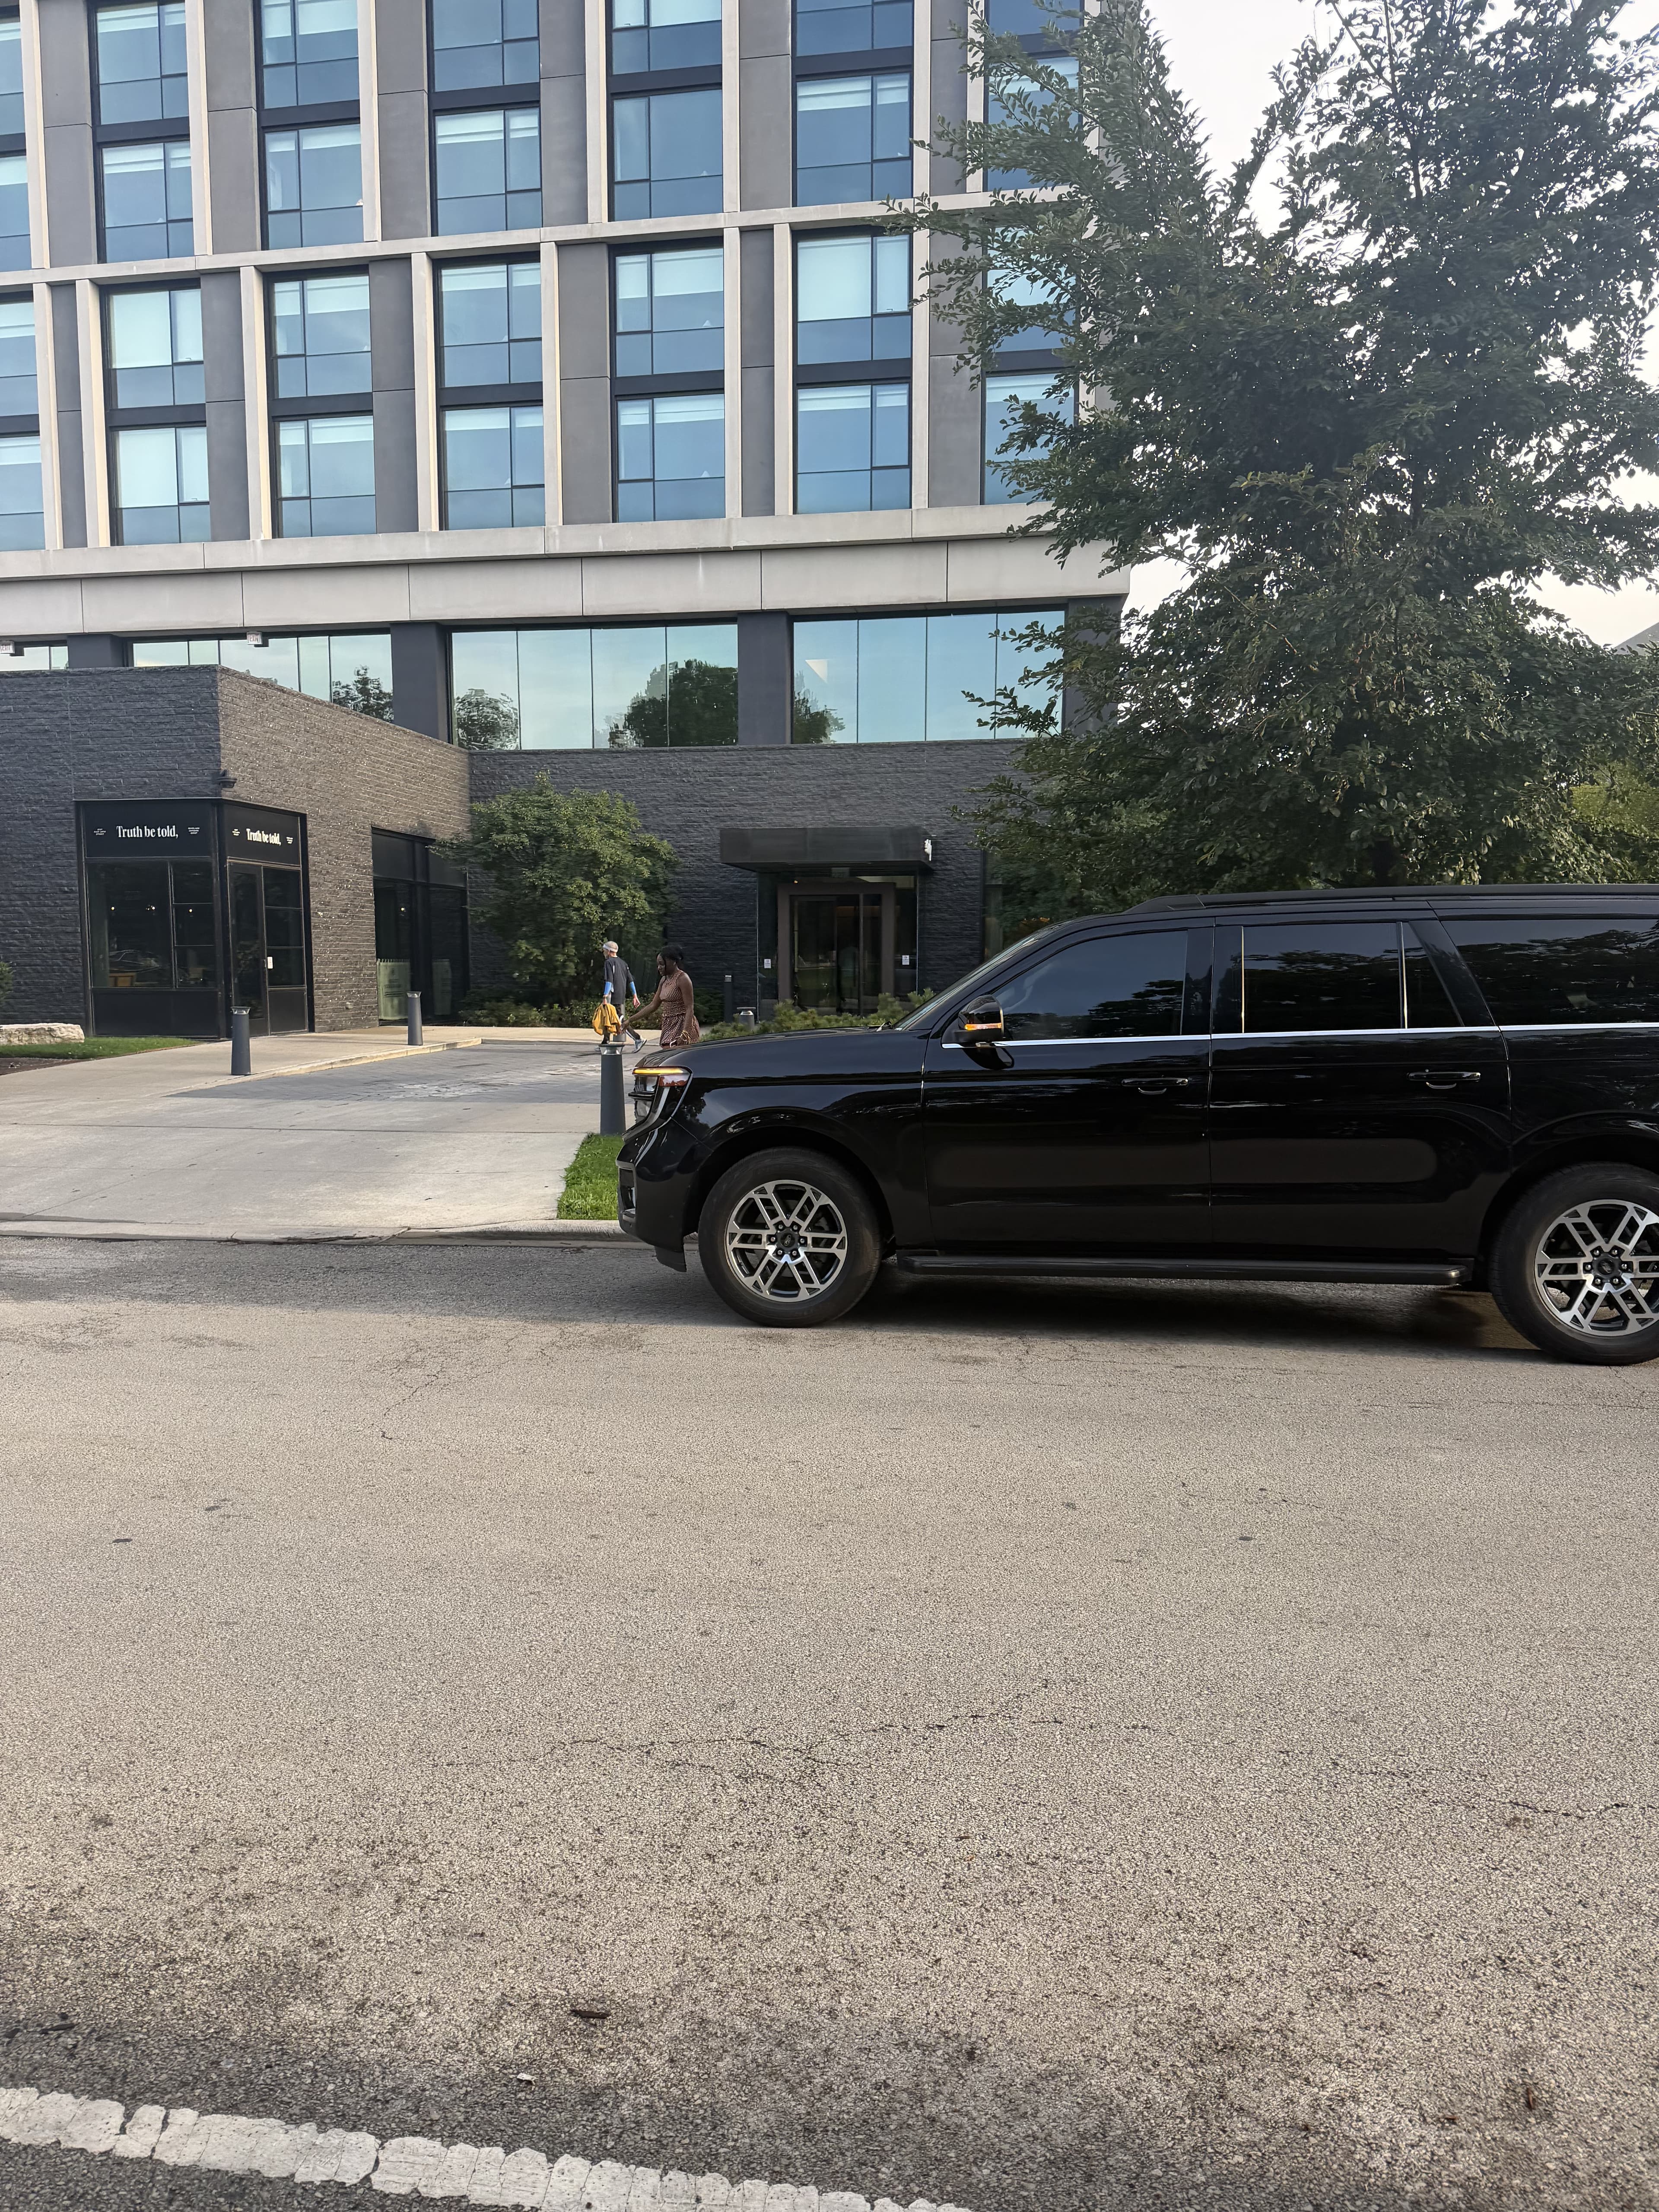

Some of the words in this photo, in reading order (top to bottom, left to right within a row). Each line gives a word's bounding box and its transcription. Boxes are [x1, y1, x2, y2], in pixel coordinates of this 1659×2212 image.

[116, 826, 143, 837] Truth
[144, 826, 156, 837] be
[157, 825, 178, 839] told,
[246, 828, 262, 842] Truth
[261, 830, 269, 843] be
[269, 833, 281, 846] told,
